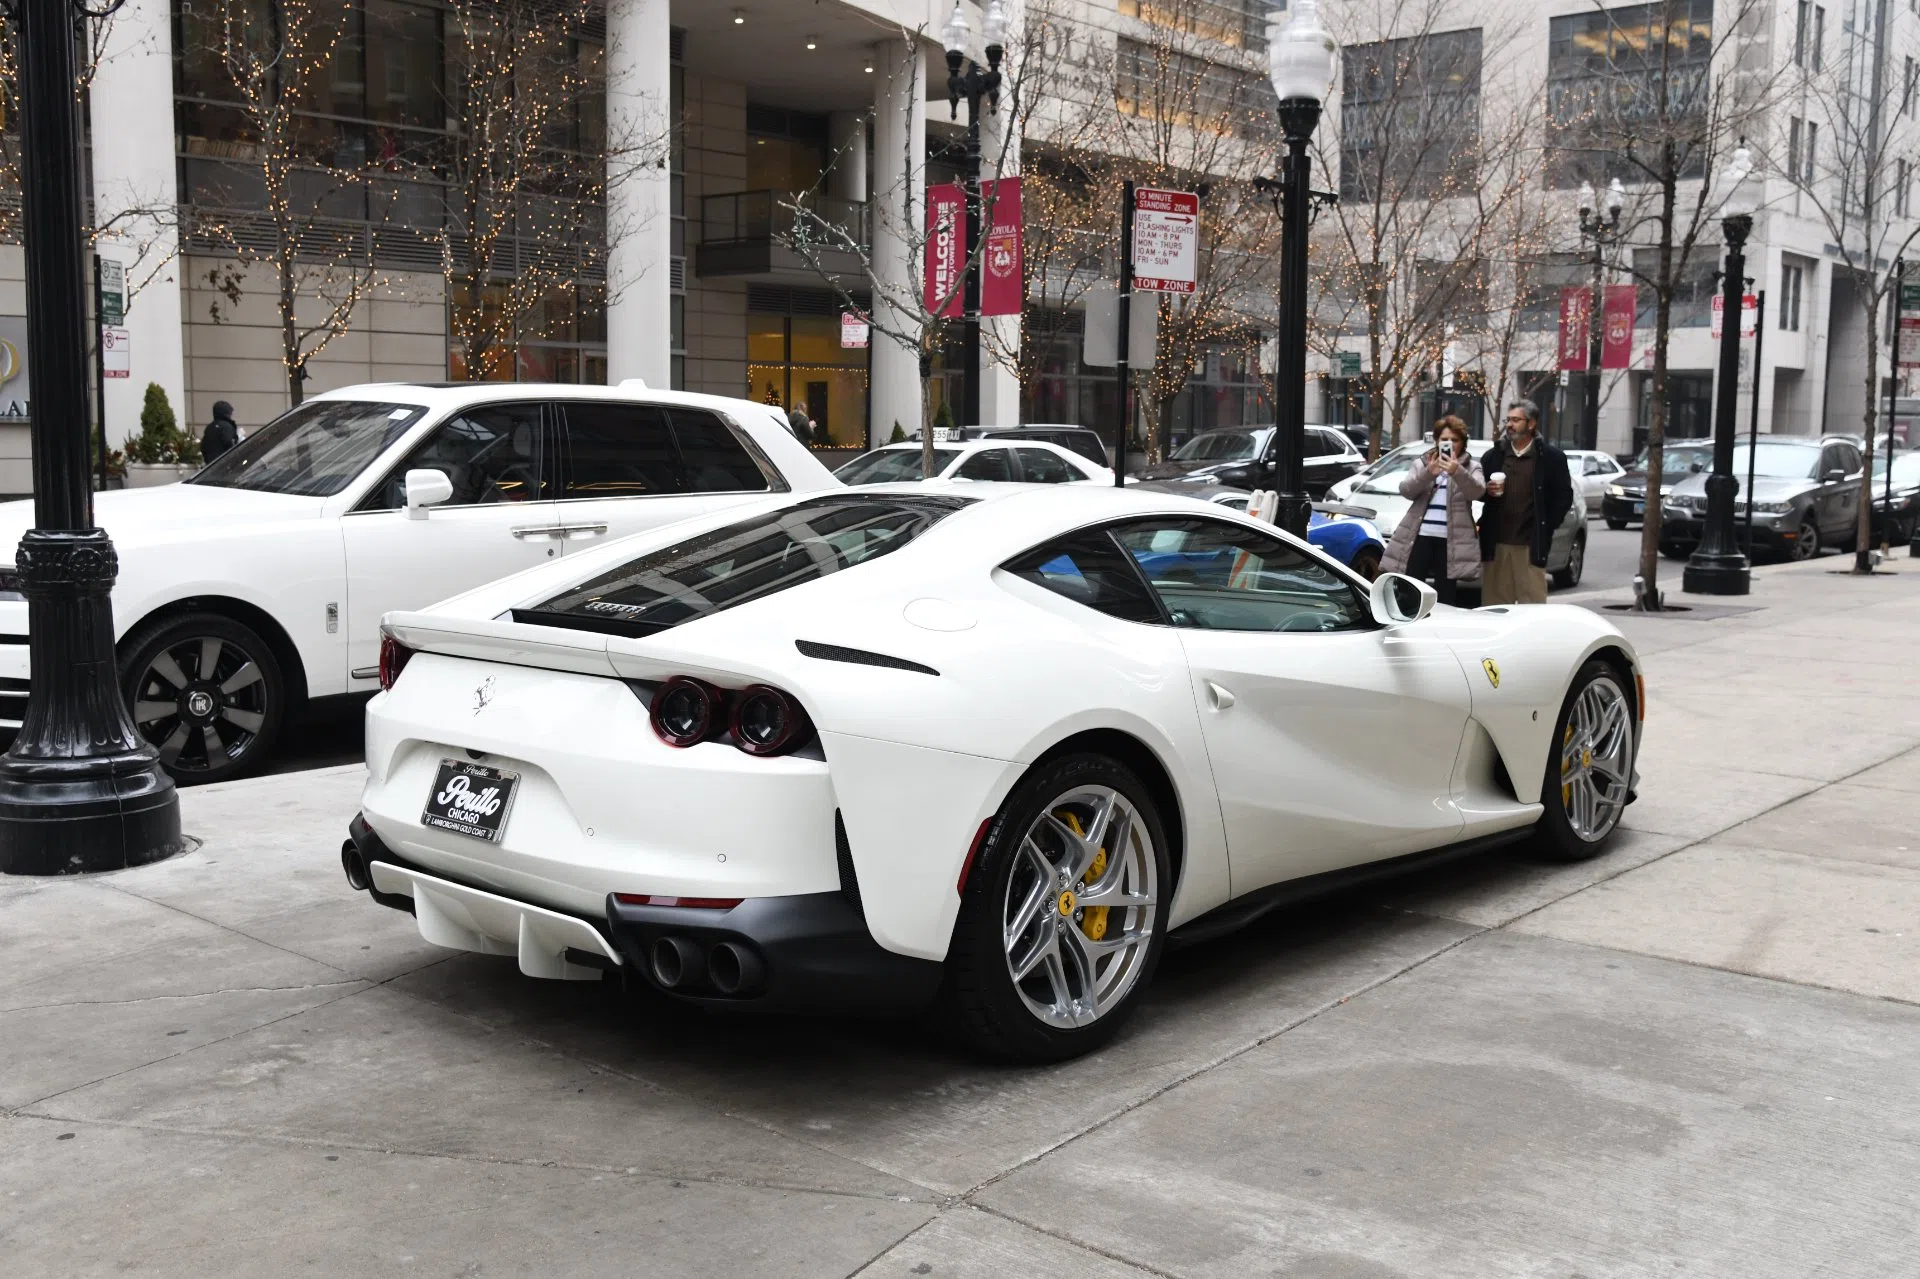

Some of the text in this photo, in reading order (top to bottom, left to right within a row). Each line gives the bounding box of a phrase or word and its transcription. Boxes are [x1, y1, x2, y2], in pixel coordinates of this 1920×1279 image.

[1139, 191, 1172, 202] 15 MINUTE
[1139, 200, 1191, 213] STANDING ZONE
[1138, 214, 1152, 222] USE
[990, 224, 1017, 236] OYOLA
[1138, 222, 1194, 235] FLASHING LIGHTS
[1137, 247, 1145, 255] 10
[1138, 239, 1153, 247] MON
[1160, 241, 1183, 250] THURS
[1137, 256, 1149, 264] FRI
[1154, 257, 1169, 266] SUN
[1137, 278, 1190, 292] TOW ZONE
[463, 764, 489, 777] Perillo
[437, 775, 500, 816] Perillo
[447, 807, 479, 824] CHICAGO
[430, 817, 487, 837] LAMBORGHINI GOLD COAST
